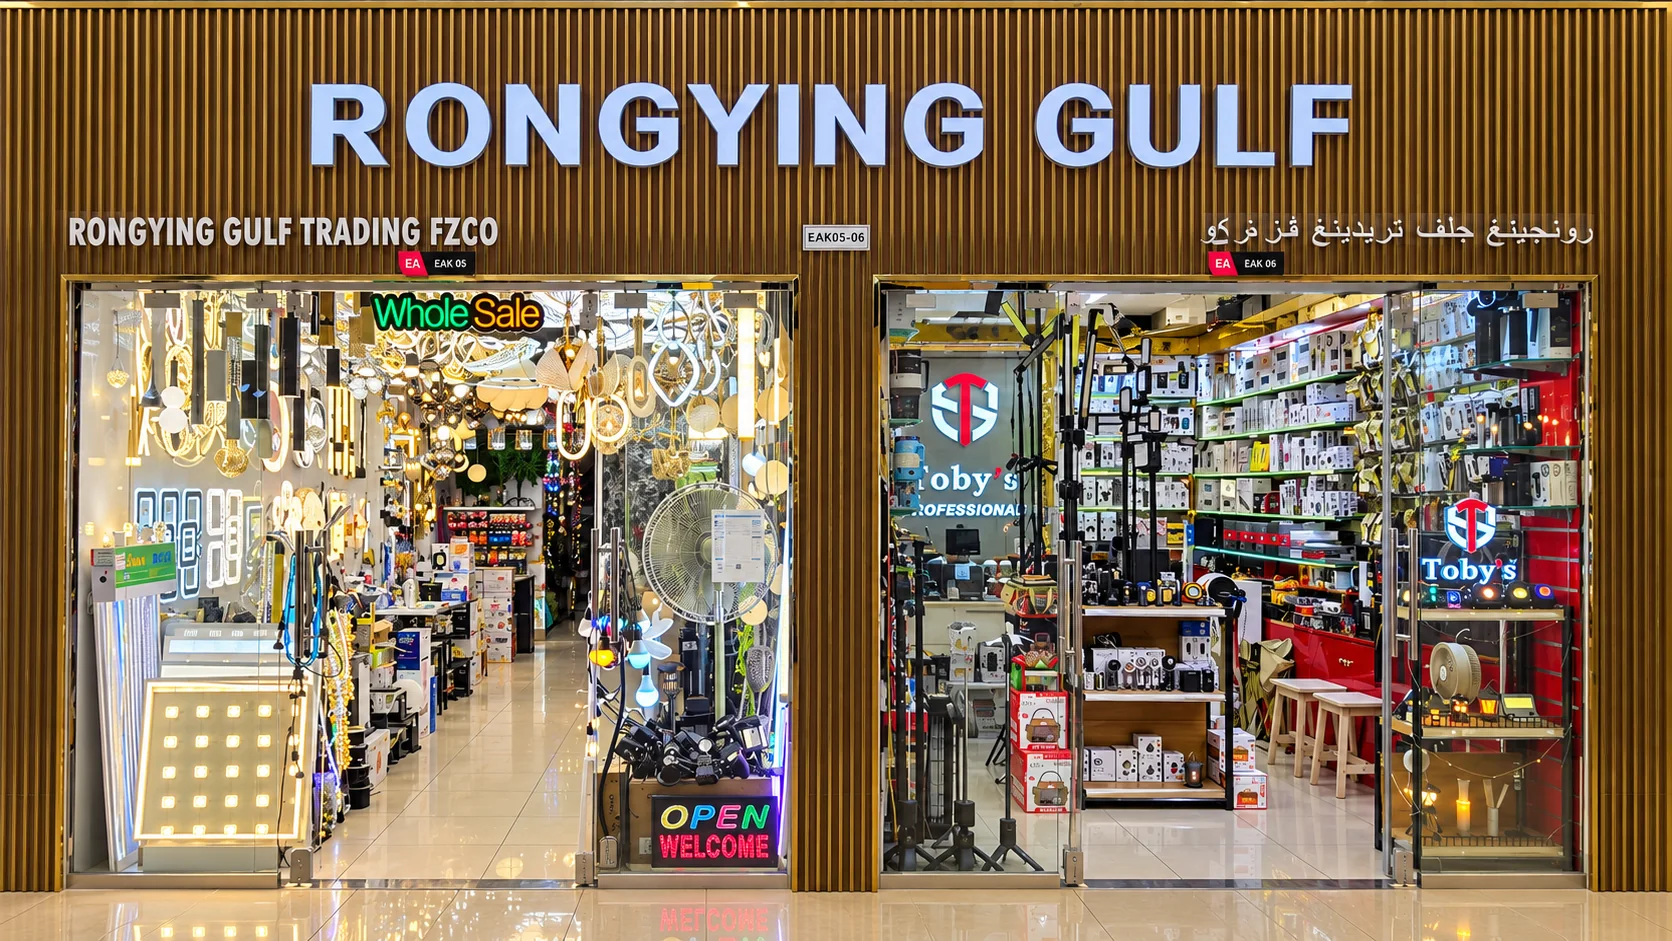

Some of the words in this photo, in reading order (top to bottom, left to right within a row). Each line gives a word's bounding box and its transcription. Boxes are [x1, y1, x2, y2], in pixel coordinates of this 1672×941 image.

[310, 83, 983, 168] RONGYING
[1036, 83, 1354, 169] GULF
[69, 216, 215, 247] RONGYING
[223, 216, 292, 247] GULF
[300, 216, 421, 247] TRADING
[430, 216, 499, 247] FZCO
[807, 232, 865, 243] EAK05-06
[1311, 218, 1404, 248] تريدينغ
[1416, 216, 1475, 244] جلف
[1486, 218, 1595, 248] رونجينغ
[405, 258, 421, 269] EA
[434, 259, 453, 268] EAK
[455, 259, 467, 268] 05
[1215, 258, 1231, 269] EA
[1244, 259, 1263, 268] EAK
[1265, 259, 1277, 268] 06
[374, 297, 469, 328] Whole
[474, 297, 540, 328] Sale
[660, 804, 770, 830] OPEN
[659, 834, 769, 859] WELCOME
